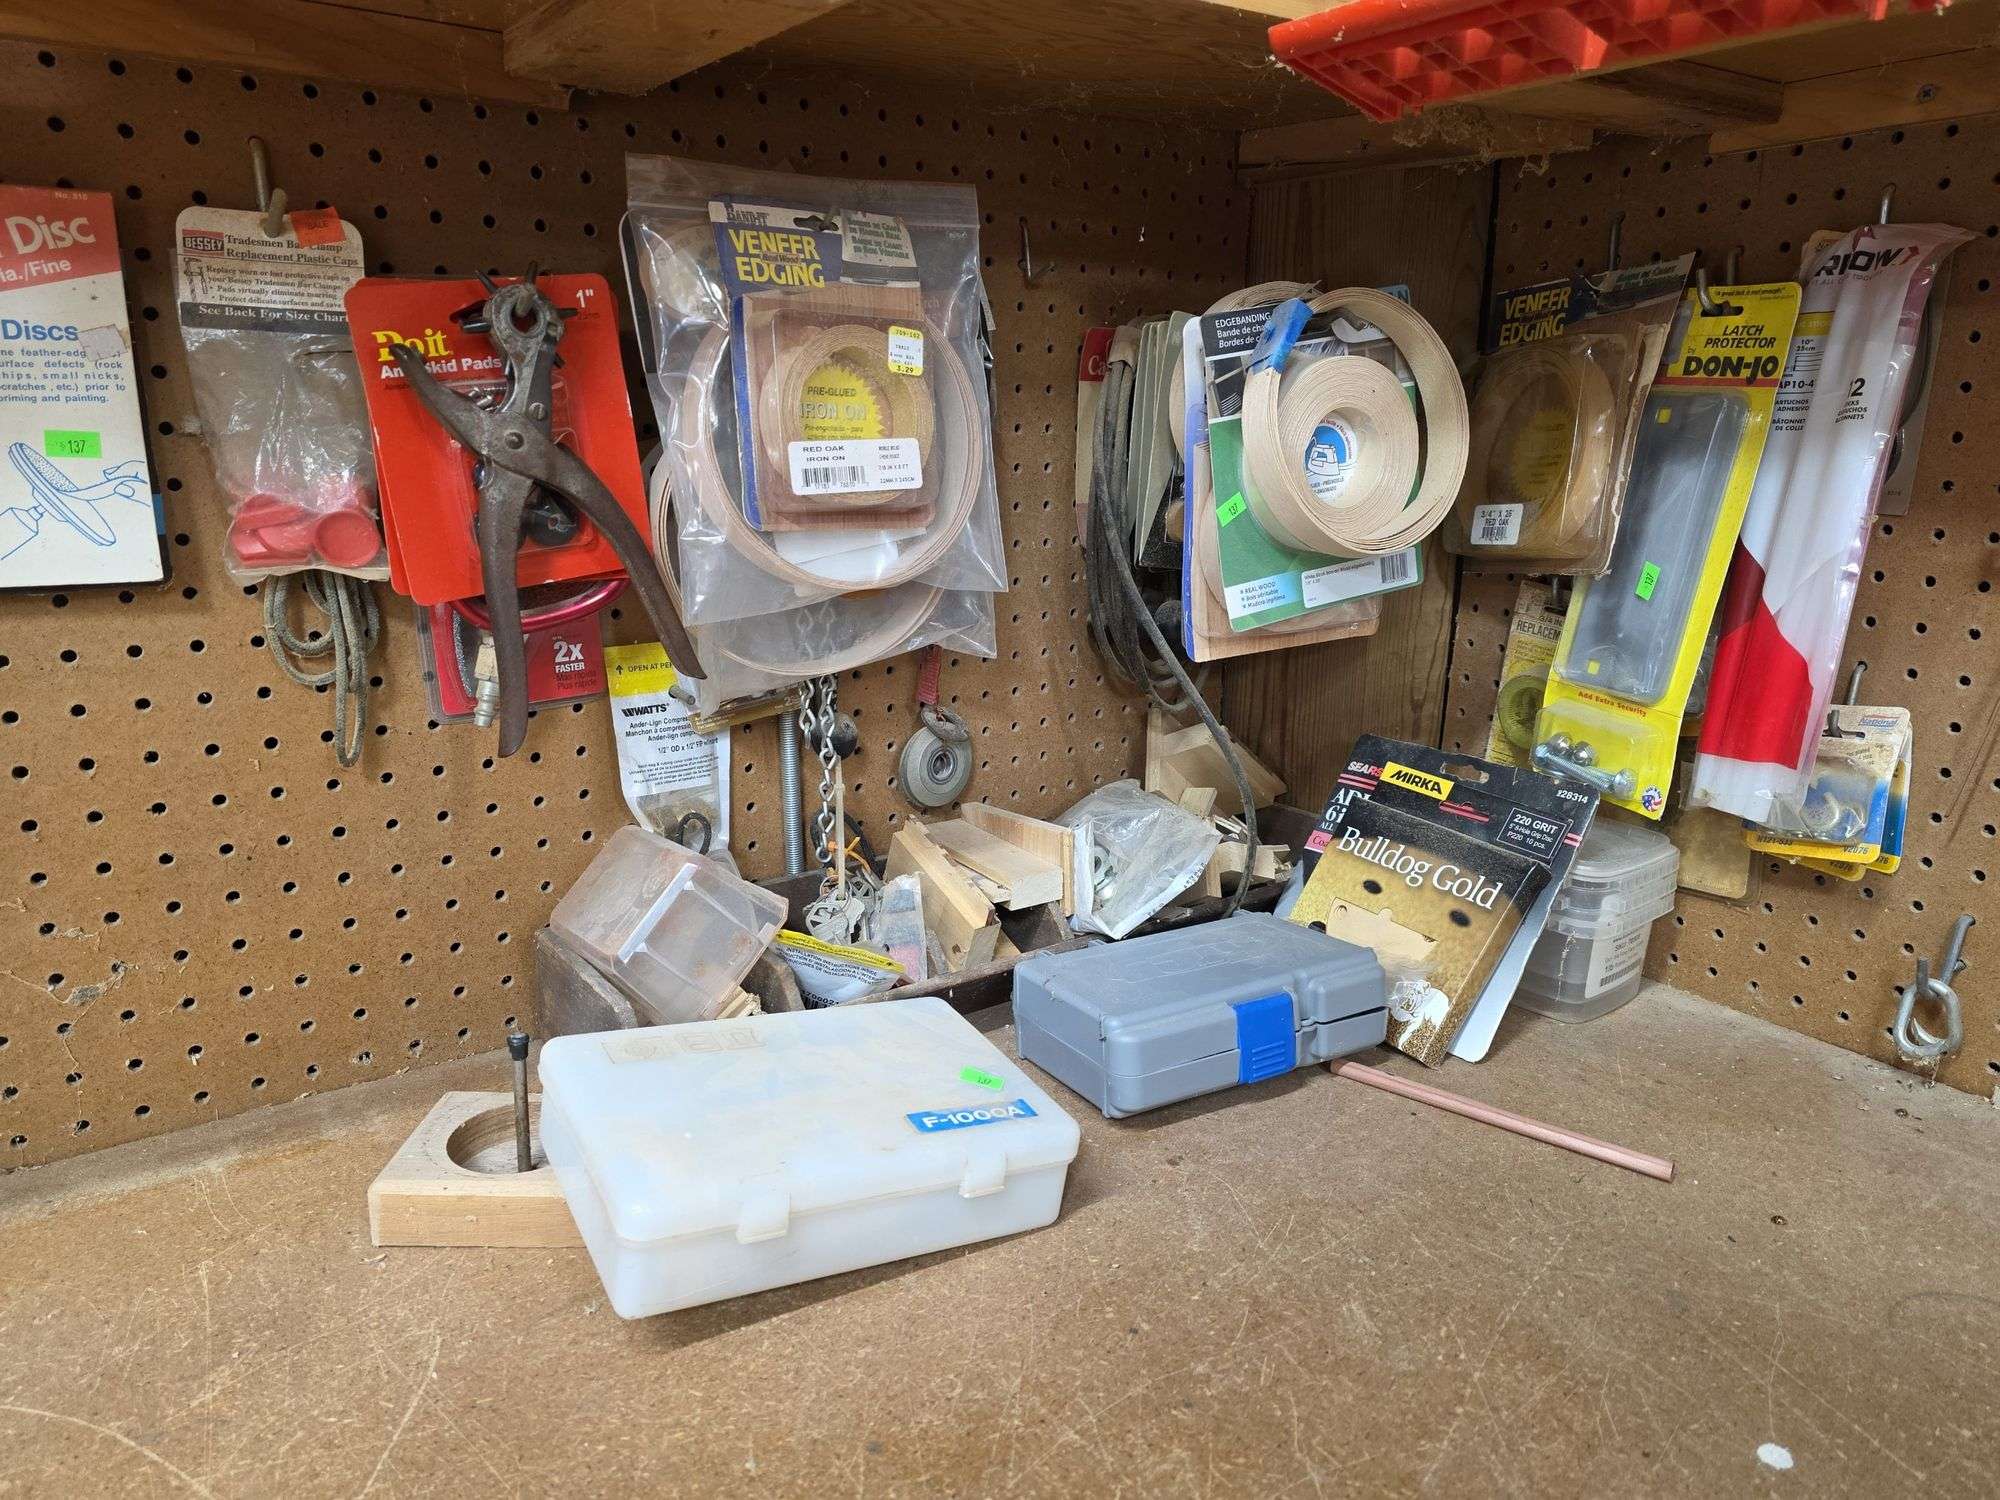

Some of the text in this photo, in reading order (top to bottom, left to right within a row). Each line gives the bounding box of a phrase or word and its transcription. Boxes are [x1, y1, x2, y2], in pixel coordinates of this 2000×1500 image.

[5, 216, 96, 255] Disc
[225, 234, 283, 249] Tradesmen
[287, 239, 300, 249] Ba
[185, 237, 223, 251] BESSEY
[728, 229, 821, 260] VENEER
[227, 248, 359, 267] Replacement Plastic Caps
[0, 259, 72, 283] ia./Fine
[735, 256, 825, 289] EDGING
[1505, 287, 1571, 320] VENEER
[199, 304, 221, 315] See
[225, 306, 256, 319] Back
[260, 309, 283, 320] For
[285, 309, 311, 321] Size
[1215, 311, 1272, 329] EDGEBANDING
[1, 319, 79, 341] Discs
[1217, 328, 1240, 338] Bande
[1500, 313, 1566, 345] EDGING
[1722, 325, 1765, 336] LATCH
[1219, 337, 1244, 348] Bordes
[1245, 335, 1255, 344] de
[1704, 337, 1776, 349] PROTECTOR
[21, 348, 87, 359] feather-edg
[0, 360, 123, 370] urface defects (rock
[461, 355, 502, 371] Pads
[1682, 355, 1779, 385] DON-JO
[1, 372, 37, 381] hips,
[84, 373, 125, 381] nicks,
[86, 384, 110, 392] prior
[807, 386, 857, 397] PRE-GLUED
[42, 394, 60, 402] and
[65, 394, 110, 403] painting.
[67, 440, 86, 454] 137
[1228, 503, 1238, 516] 137
[1643, 573, 1655, 586] 137
[553, 640, 584, 663] 2x
[555, 662, 585, 673] FASTER
[628, 663, 659, 673] OPEN AT
[1578, 690, 1648, 717] Add Extra Security
[625, 728, 654, 738] Manchon
[659, 723, 692, 735] compressio
[630, 720, 662, 729] Ander-Lign
[648, 734, 679, 743] Ander-lign
[1348, 761, 1383, 777] SEARS
[1390, 770, 1443, 795] MIRKA
[1320, 822, 1334, 831] ALL
[1514, 814, 1558, 834] 220 GRIT
[1507, 831, 1523, 841] P220
[1526, 837, 1534, 845] 10
[1336, 826, 1503, 911] Bulldog Gold
[922, 1105, 1025, 1128] F-1000A
